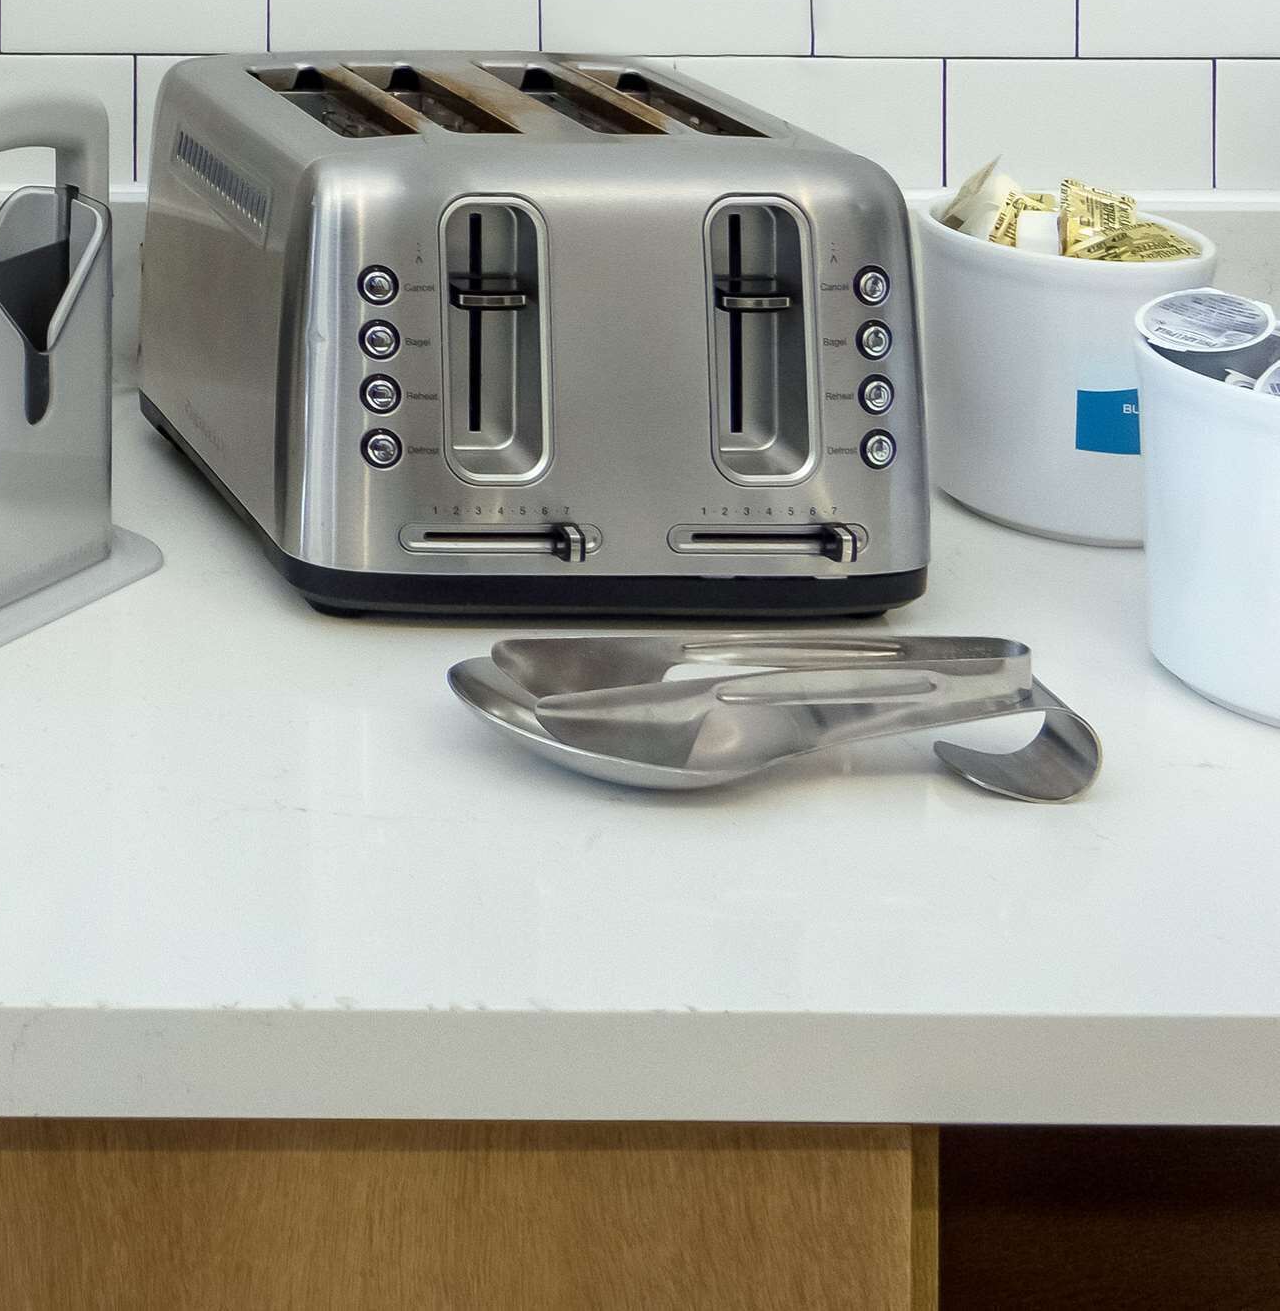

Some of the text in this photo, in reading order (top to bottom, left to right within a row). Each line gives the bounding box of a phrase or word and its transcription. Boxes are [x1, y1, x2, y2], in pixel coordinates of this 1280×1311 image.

[404, 282, 435, 292] Cancel
[405, 337, 432, 348] Bagel
[406, 391, 439, 401] Reheat
[433, 505, 570, 515] 1 2 3 4 5 6 7
[701, 506, 838, 516] 1 2 3 4 5 6 7
